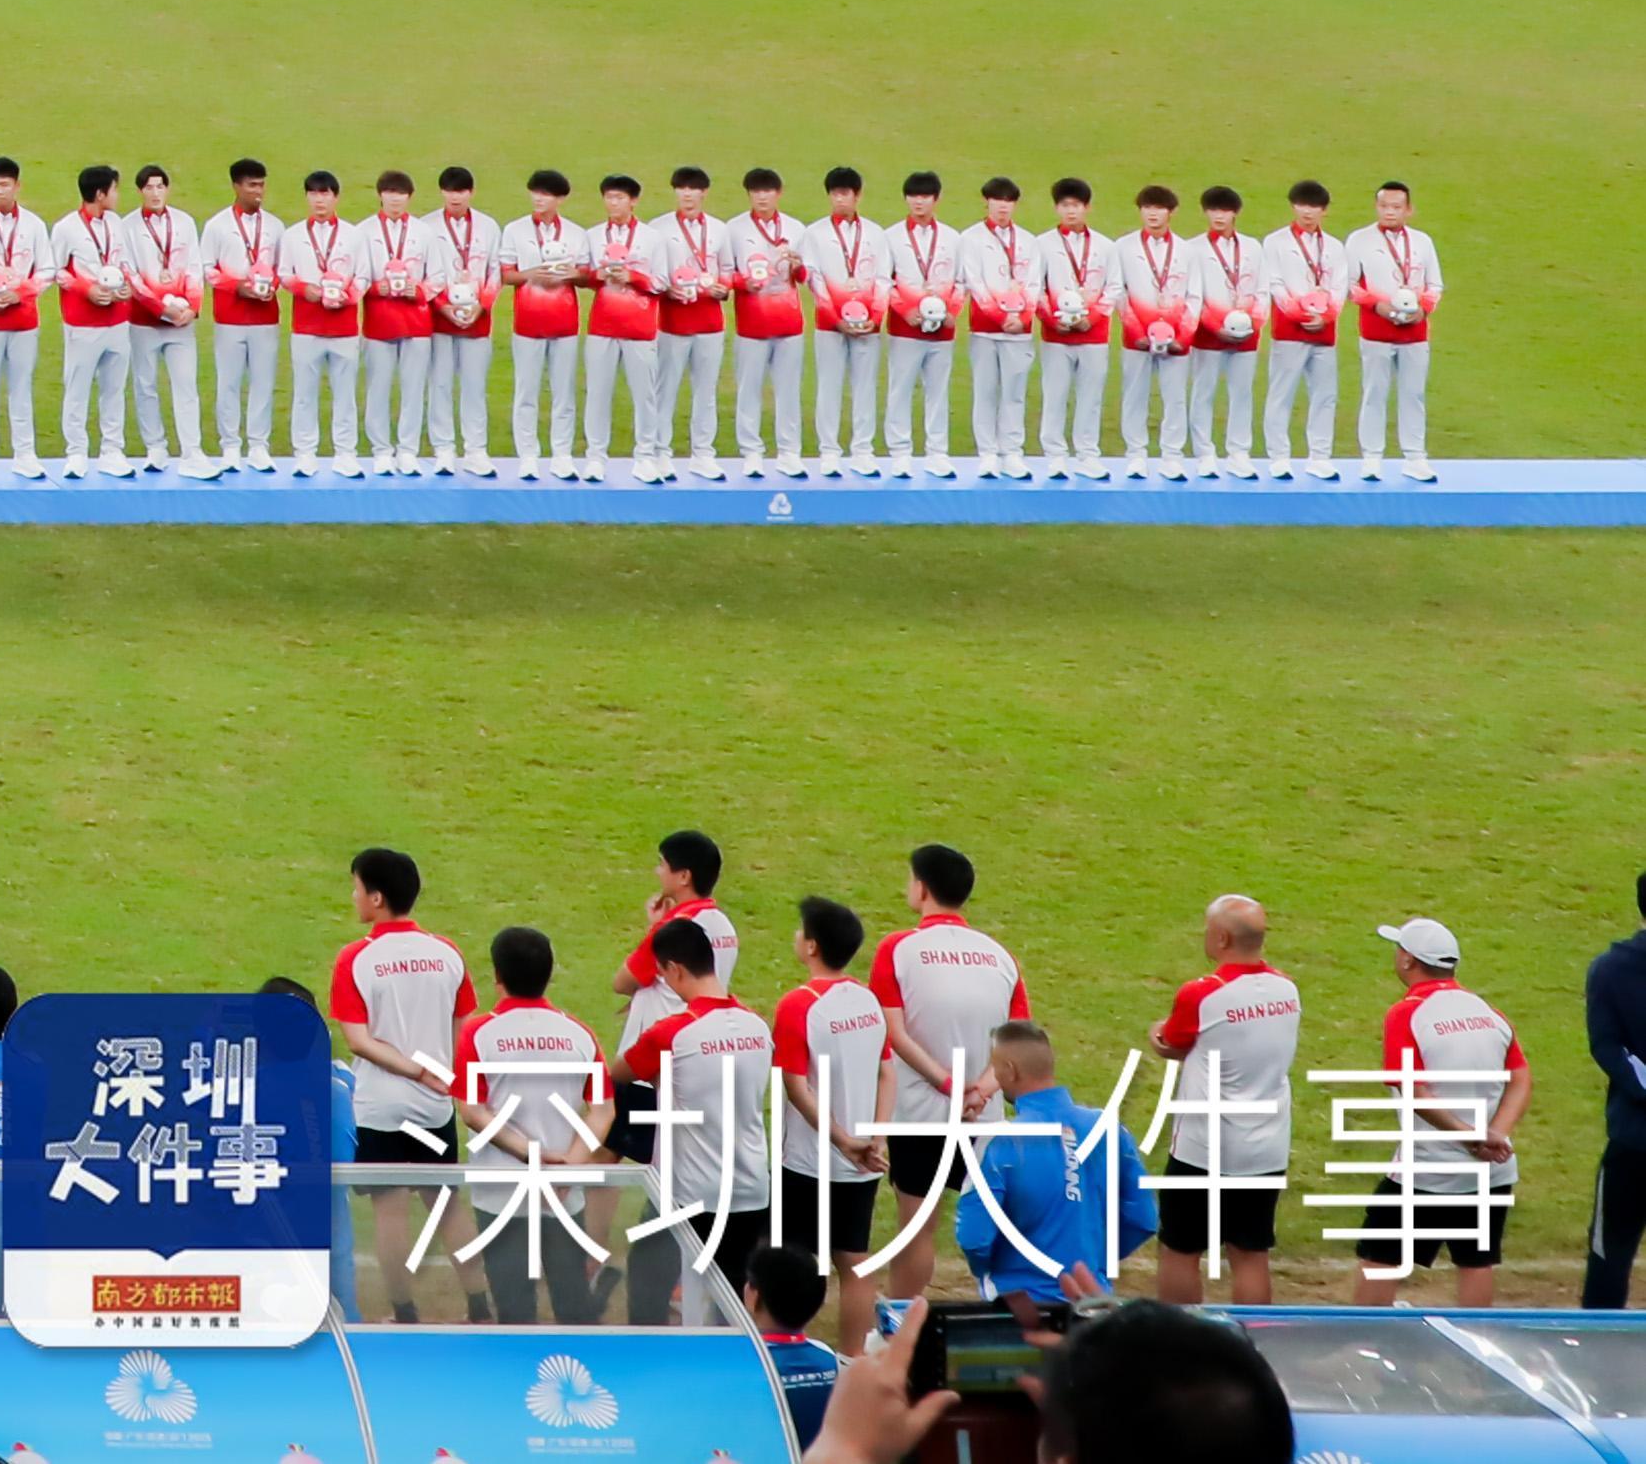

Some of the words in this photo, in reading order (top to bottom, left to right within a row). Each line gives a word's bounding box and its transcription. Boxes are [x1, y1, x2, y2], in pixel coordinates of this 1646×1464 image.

[920, 950, 955, 967] SHAN
[374, 960, 410, 978] SHAN
[1226, 1004, 1265, 1024] SHAN
[830, 1016, 857, 1035] SHAN
[1434, 1017, 1463, 1037] SHAN
[498, 1038, 534, 1052] SHAN
[700, 1040, 734, 1056] SHAN
